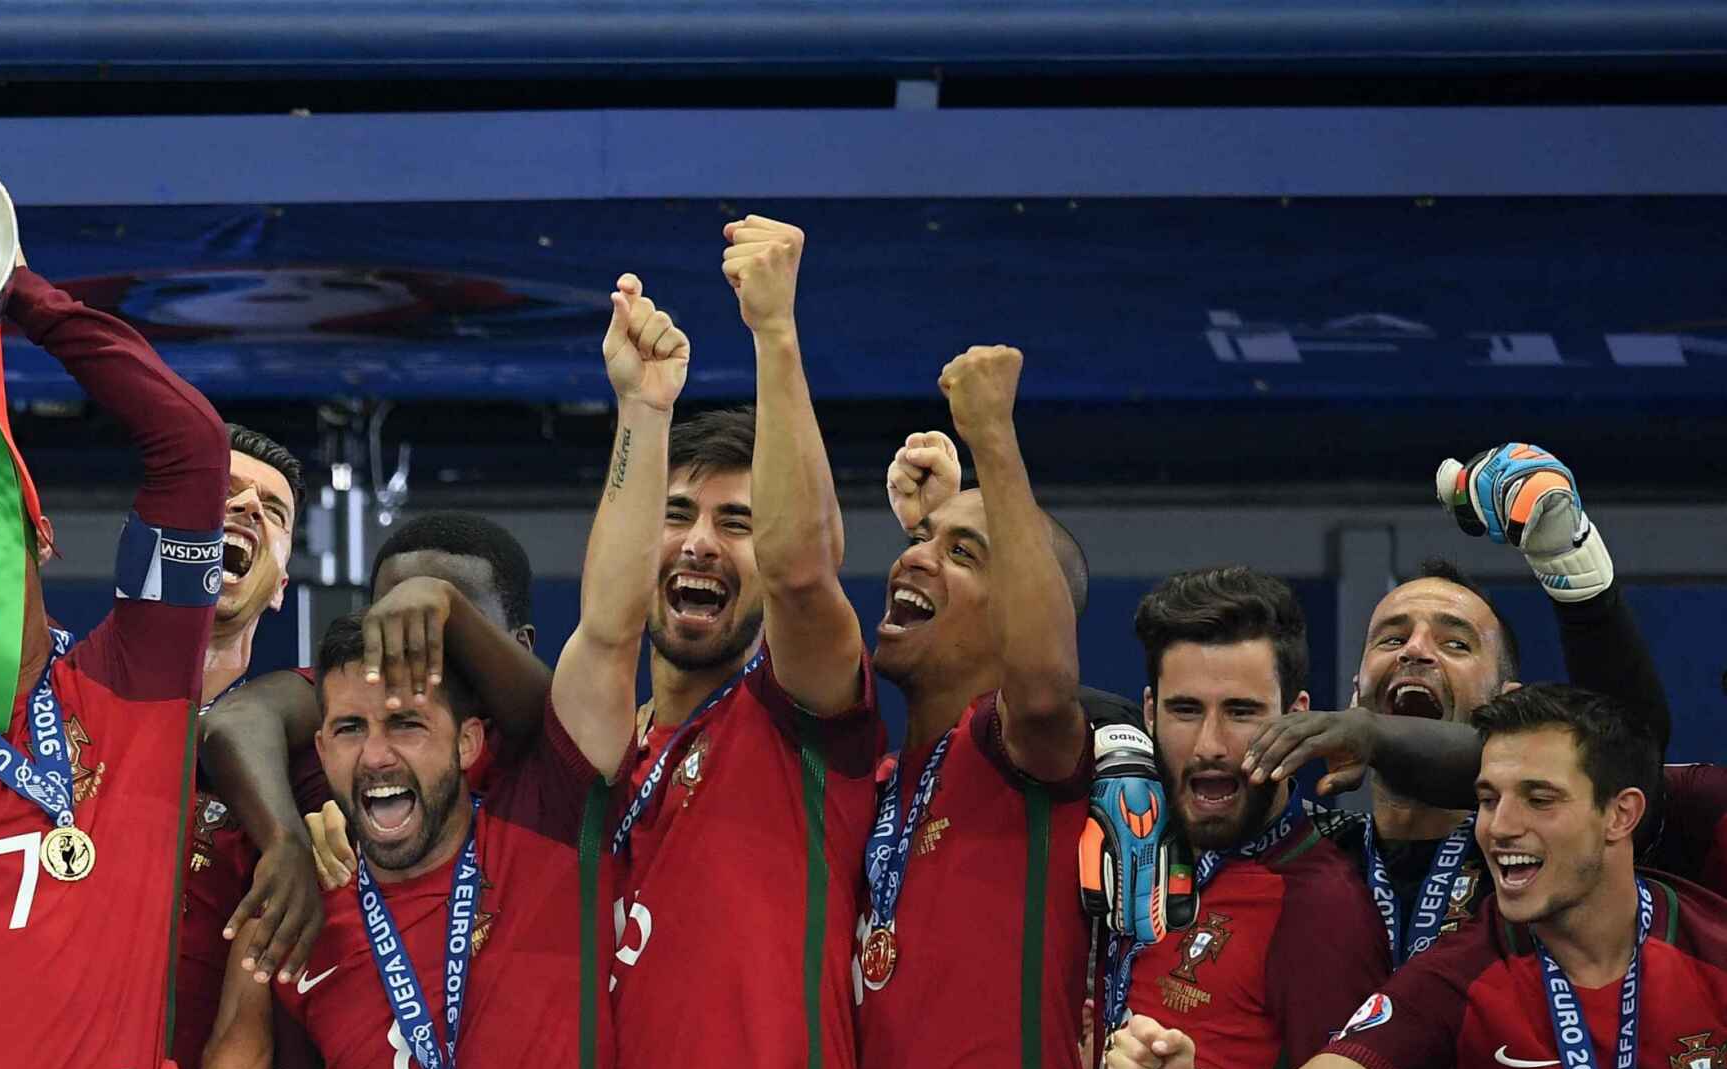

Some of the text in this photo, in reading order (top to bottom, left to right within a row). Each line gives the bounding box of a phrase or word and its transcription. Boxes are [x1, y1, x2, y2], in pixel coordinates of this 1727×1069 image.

[161, 542, 219, 560] RACISM
[33, 700, 61, 757] 2016
[362, 890, 397, 956] EURO
[448, 885, 474, 954] EURO
[1414, 871, 1454, 929] UEFA
[384, 954, 422, 1020] UEFA
[446, 959, 463, 1024] 2016
[1550, 977, 1584, 1045] EURO
